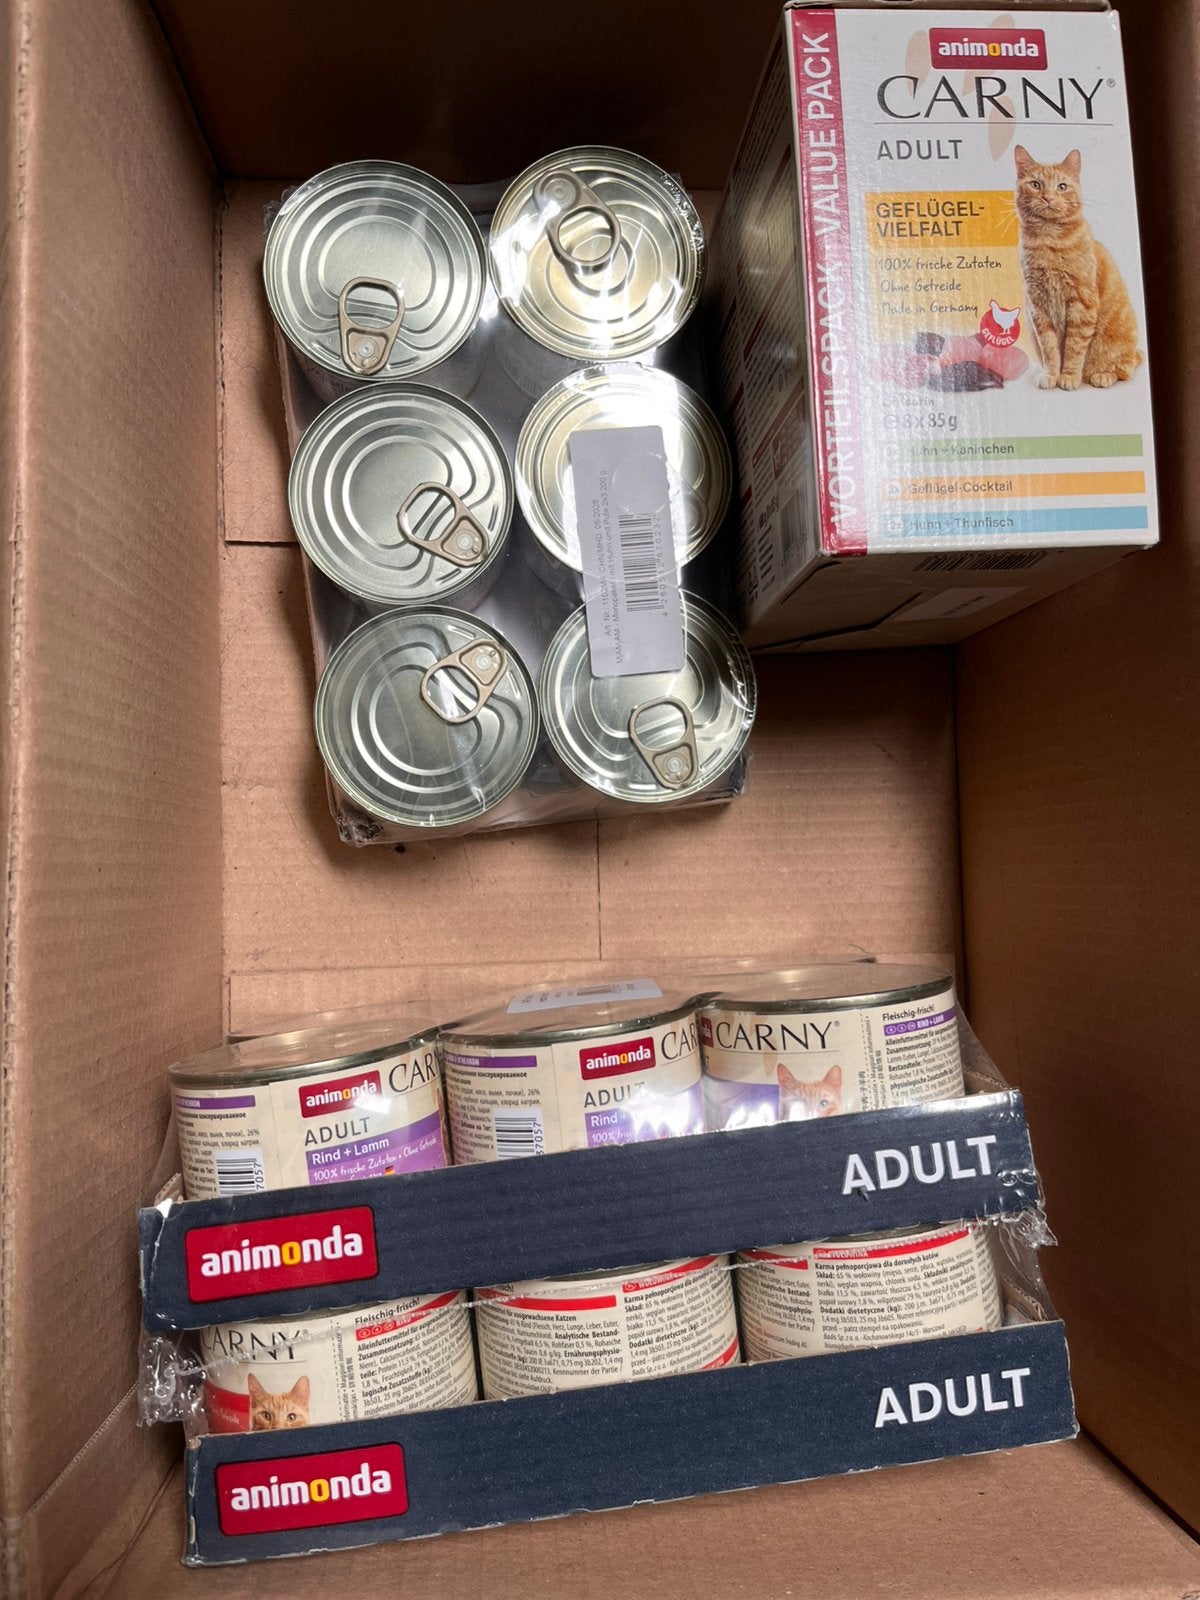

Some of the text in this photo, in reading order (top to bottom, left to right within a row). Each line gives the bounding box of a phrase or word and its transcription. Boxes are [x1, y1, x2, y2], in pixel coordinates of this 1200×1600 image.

[938, 37, 1039, 57] animonda
[877, 139, 962, 160] ADULT
[876, 198, 985, 218] GEFLÜGEL-
[877, 220, 963, 238] VIELFALT
[879, 255, 1002, 270] 100% frische Zutaten
[803, 33, 857, 523] VORTEILSPACK VALUE PACK
[880, 278, 962, 293] Ohne Getreide
[882, 300, 978, 317] Made in Germany
[982, 327, 1015, 346] GEFLÜGEL
[951, 443, 1015, 456] Kaninchen
[908, 480, 1013, 495] Geflügel-Cocktail
[909, 518, 941, 530] Huhn
[954, 517, 1013, 528] Thunfisch
[882, 1003, 935, 1022] Fleischig-frisch!
[586, 1046, 652, 1071] animonda
[305, 1080, 377, 1108] animonda
[527, 1088, 541, 1096] 26%
[590, 1111, 618, 1128] Rind
[246, 1127, 260, 1136] 26%
[304, 1116, 370, 1147] ADULT
[591, 1131, 615, 1143] 100%
[312, 1138, 390, 1166] Rind + Lamm
[312, 1169, 338, 1182] 100%
[340, 1162, 366, 1177] frische
[367, 1154, 397, 1170] Zutaten
[842, 1135, 997, 1195] ADULT
[201, 1225, 363, 1277] animonda
[815, 1262, 834, 1270] Karma
[882, 1260, 893, 1268] dla
[816, 1271, 835, 1279] Skład:
[624, 1294, 644, 1304] Karma
[354, 1296, 420, 1325] Fleischig-frisch!
[624, 1303, 644, 1313] Skład:
[820, 1306, 845, 1315] Dodatki
[846, 1306, 885, 1316] dietetyczne
[555, 1314, 577, 1322] Katzen
[357, 1328, 411, 1353] Alleinfuttermittel
[554, 1328, 621, 1341] Analytische Bestand-
[628, 1336, 654, 1349] Dodatki
[358, 1338, 415, 1361] Zusammensetzung:
[360, 1369, 378, 1380] teile:
[874, 1367, 1030, 1428] ADULT
[231, 1462, 392, 1511] animonda
